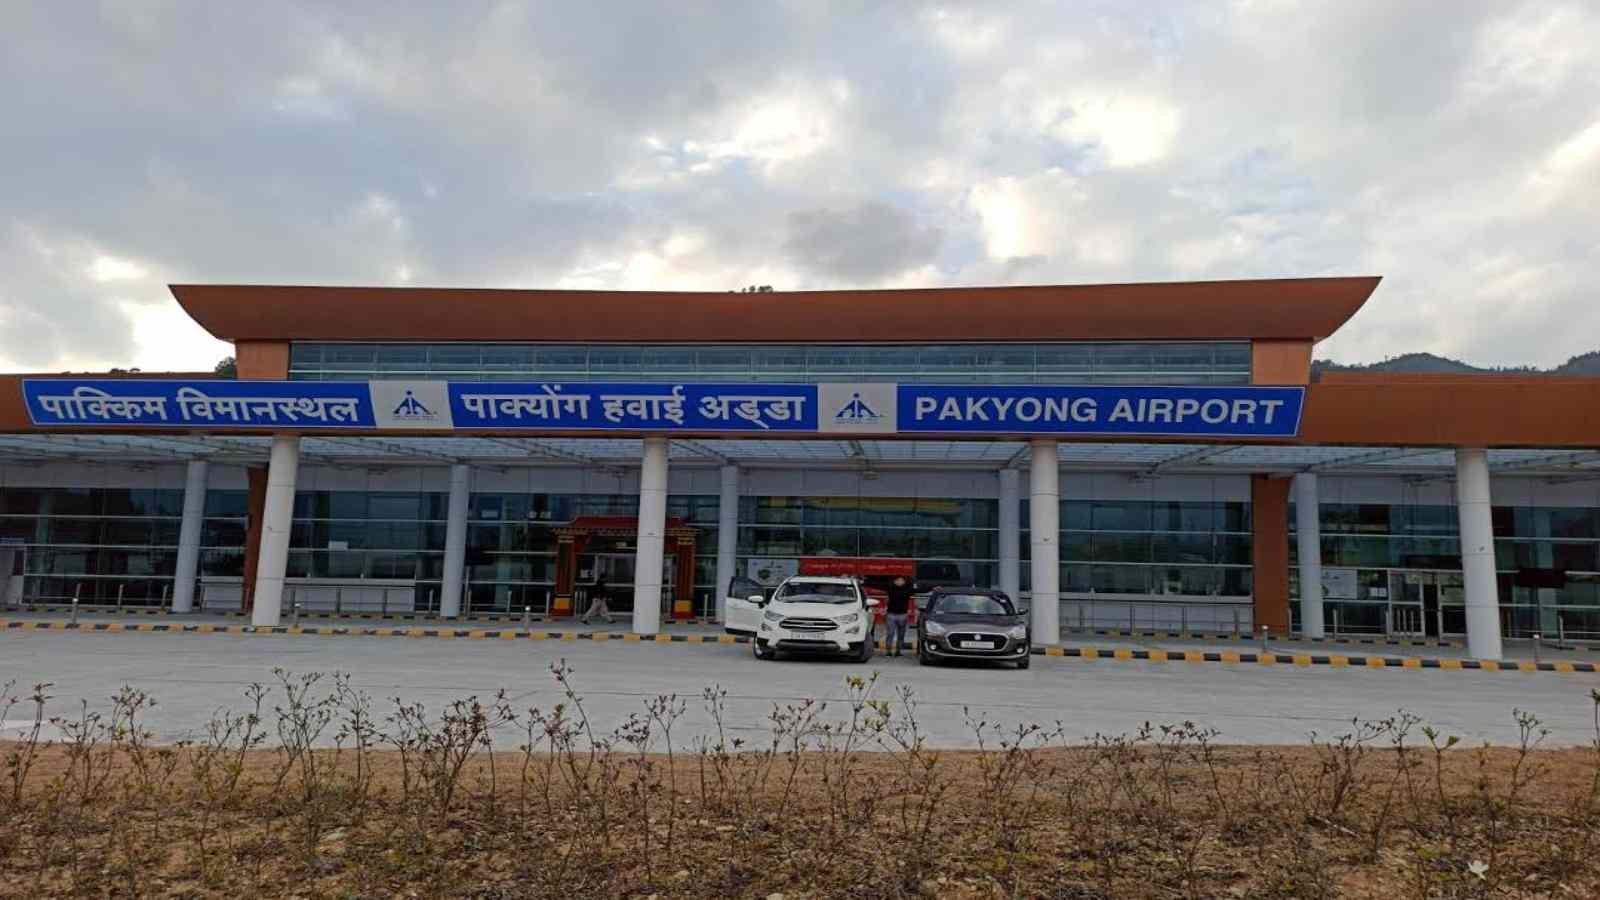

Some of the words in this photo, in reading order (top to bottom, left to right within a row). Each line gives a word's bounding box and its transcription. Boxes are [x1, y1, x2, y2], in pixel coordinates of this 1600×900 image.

[38, 387, 167, 422] पाक्किम
[176, 387, 360, 423] विमानस्थल
[461, 384, 591, 421] पाक्योंग
[599, 386, 686, 425] हवाई
[914, 396, 1098, 422] PAKYONG
[1108, 398, 1284, 425] AIRPORT
